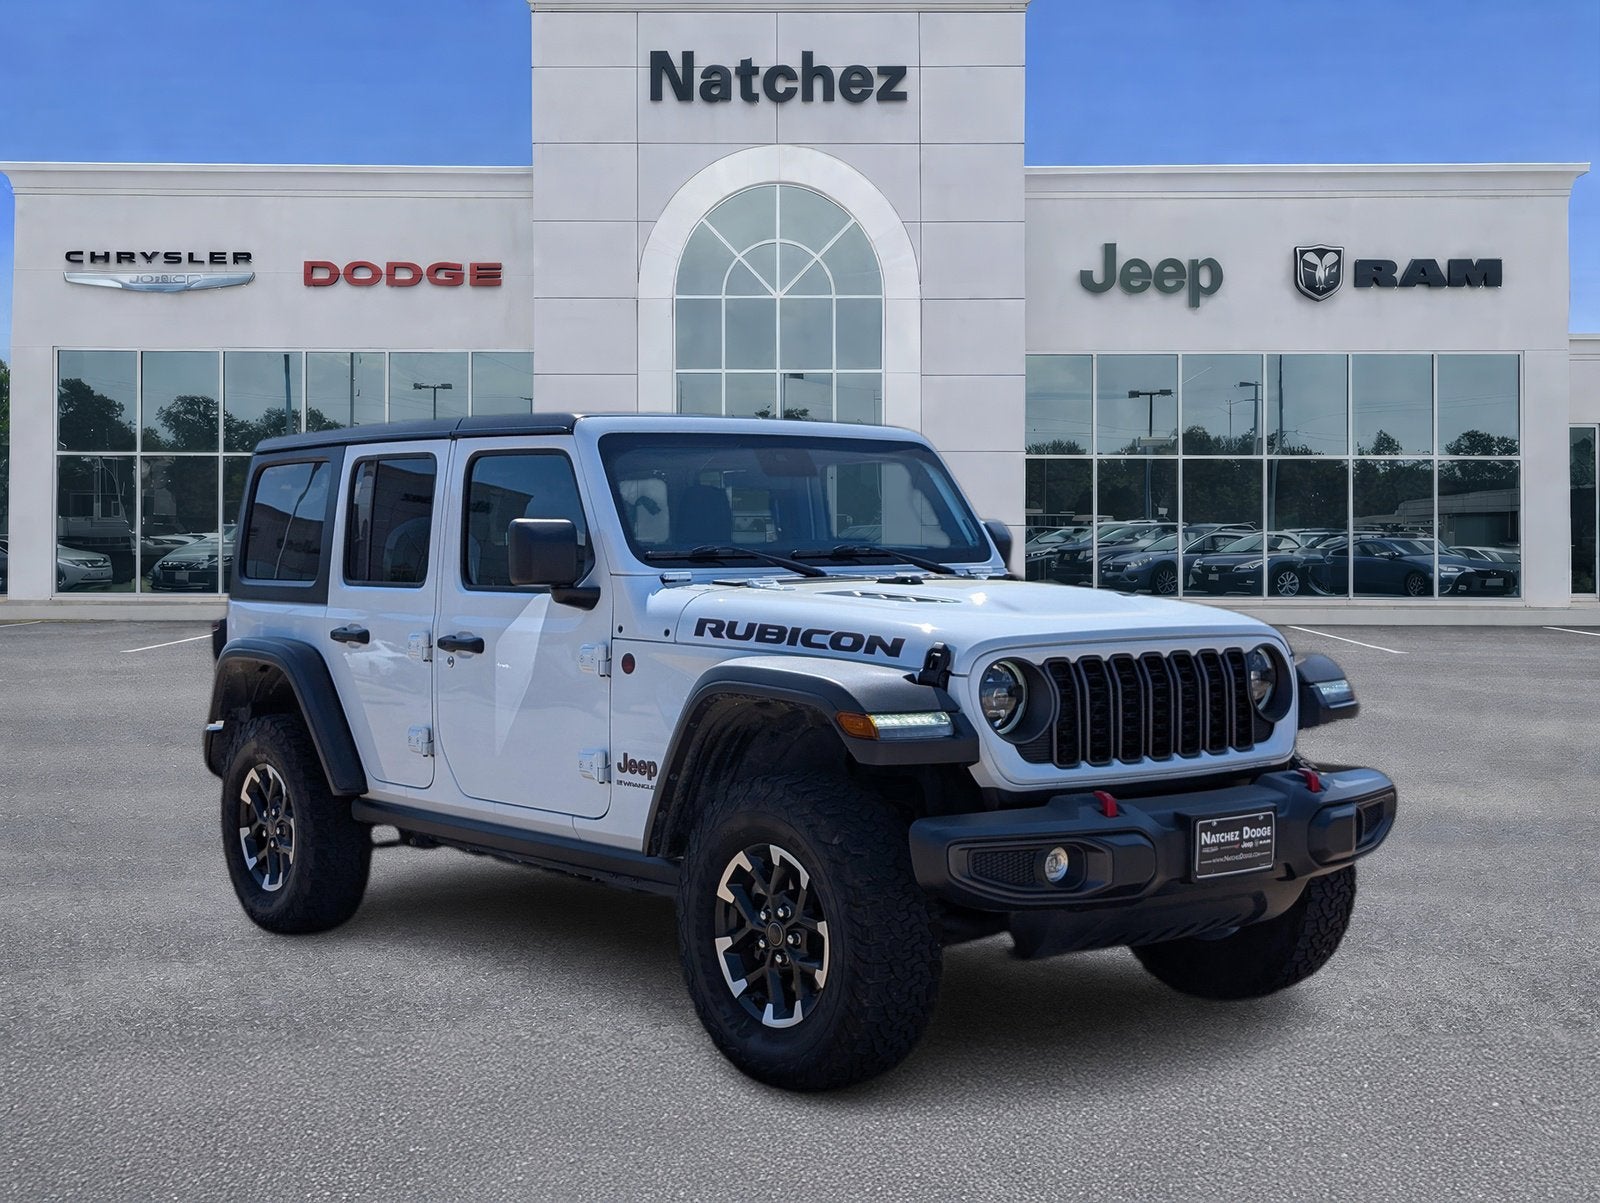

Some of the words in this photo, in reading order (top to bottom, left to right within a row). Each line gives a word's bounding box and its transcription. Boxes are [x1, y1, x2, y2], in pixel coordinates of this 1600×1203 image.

[650, 50, 908, 103] Natchez
[65, 250, 252, 264] CHRYSLER
[304, 261, 502, 287] DODGE
[1080, 243, 1223, 308] Jeep
[1354, 259, 1502, 288] RAM
[694, 617, 905, 658] RUBICON
[617, 752, 657, 781] Jeep
[623, 780, 656, 791] WRANGLE
[1201, 831, 1239, 845] NATCHEZ
[1243, 826, 1271, 839] DODGE
